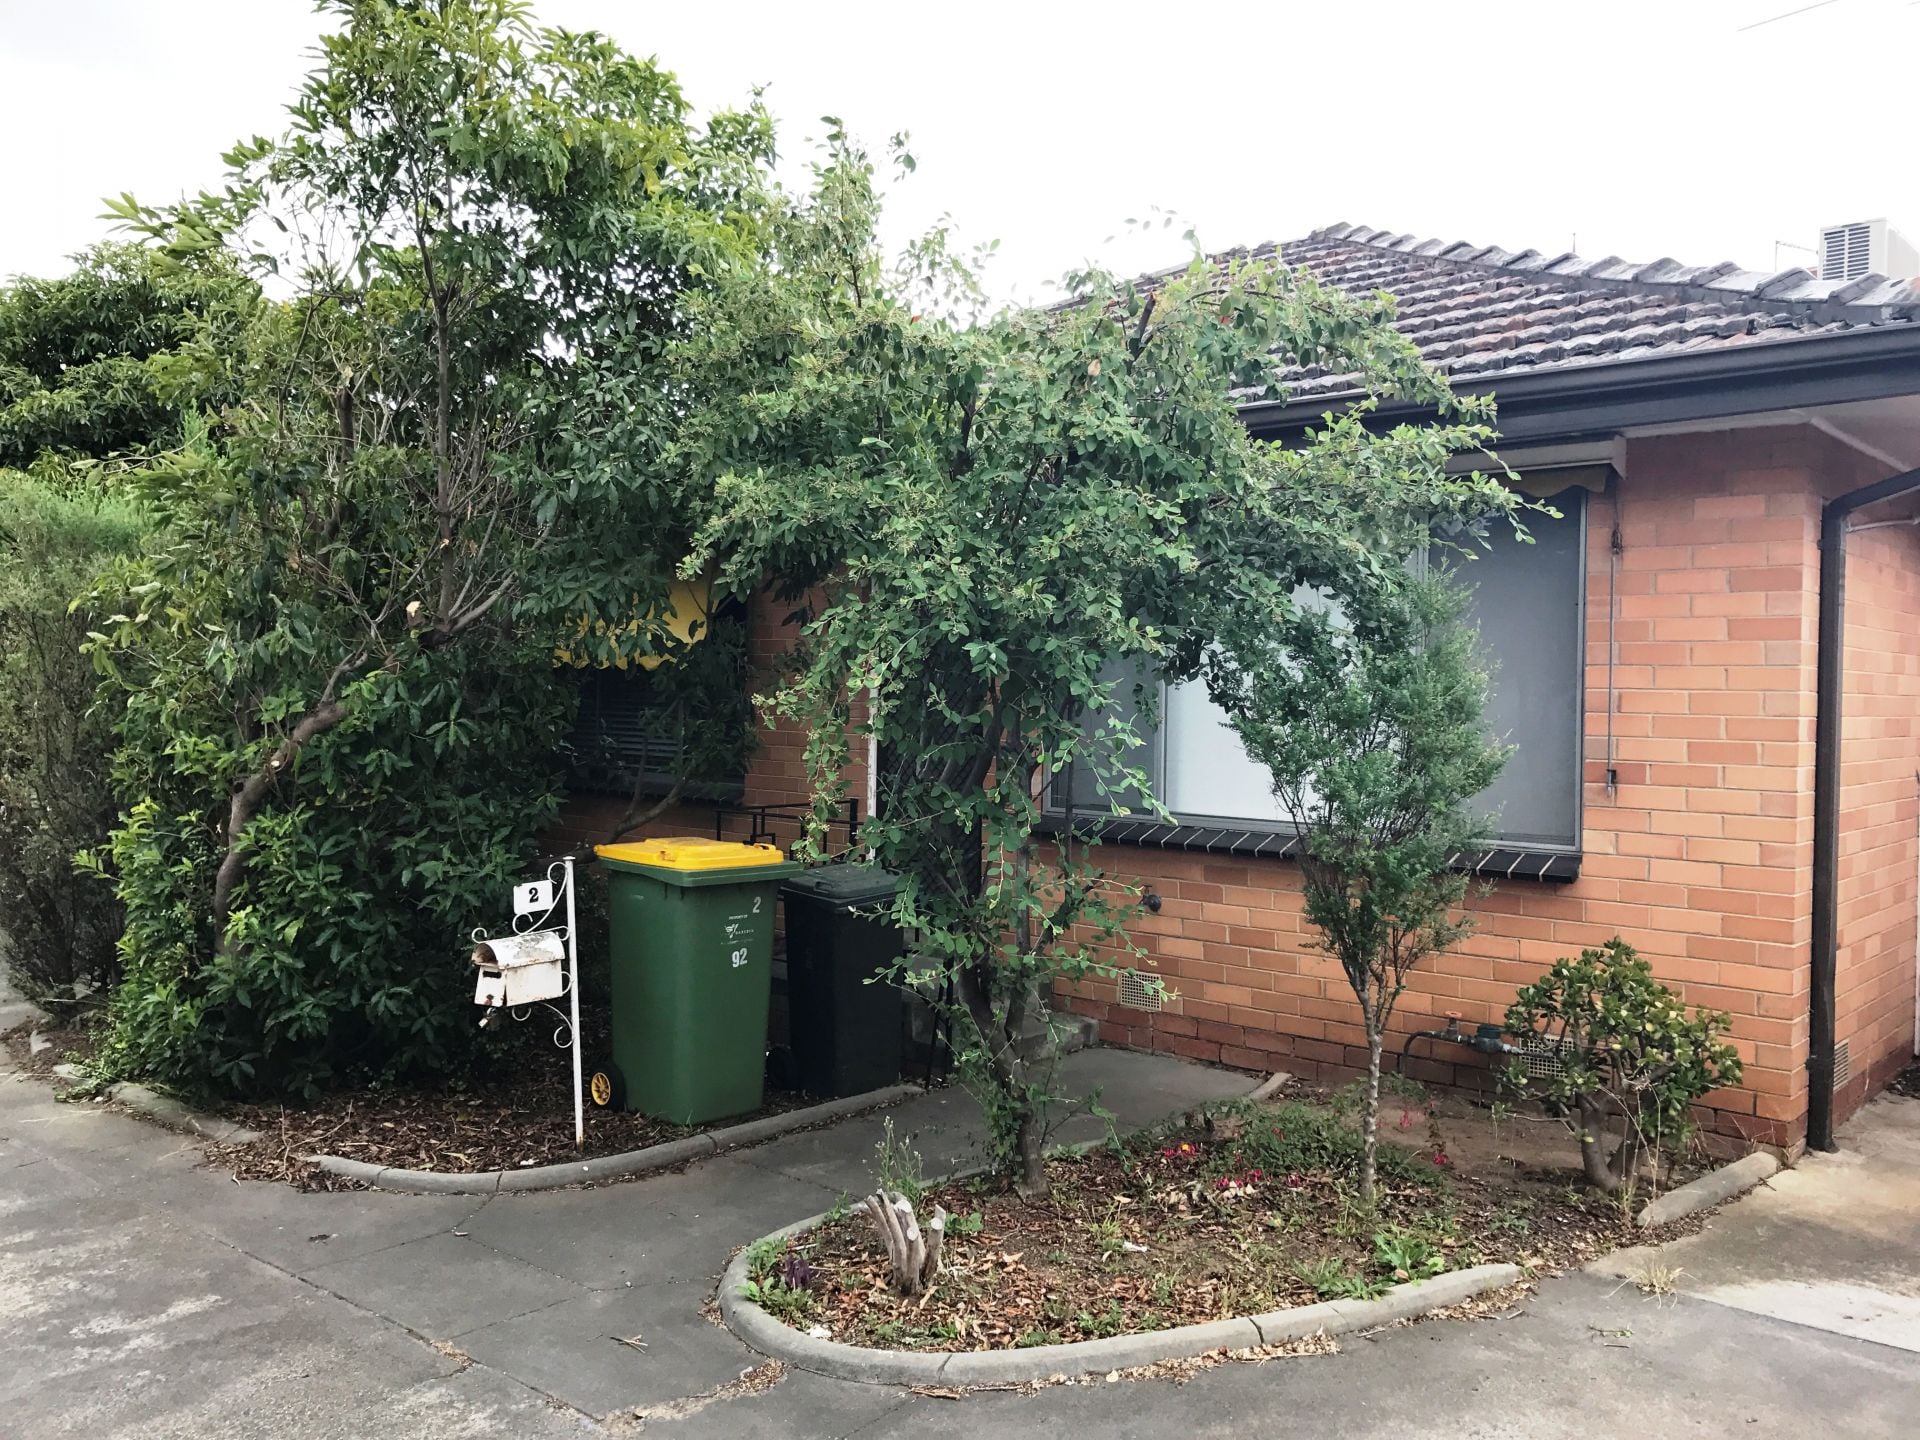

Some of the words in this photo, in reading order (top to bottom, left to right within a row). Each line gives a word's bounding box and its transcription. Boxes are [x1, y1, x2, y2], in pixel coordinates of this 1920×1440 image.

[529, 887, 539, 903] 2
[752, 896, 761, 913] 2
[732, 947, 747, 967] 92
